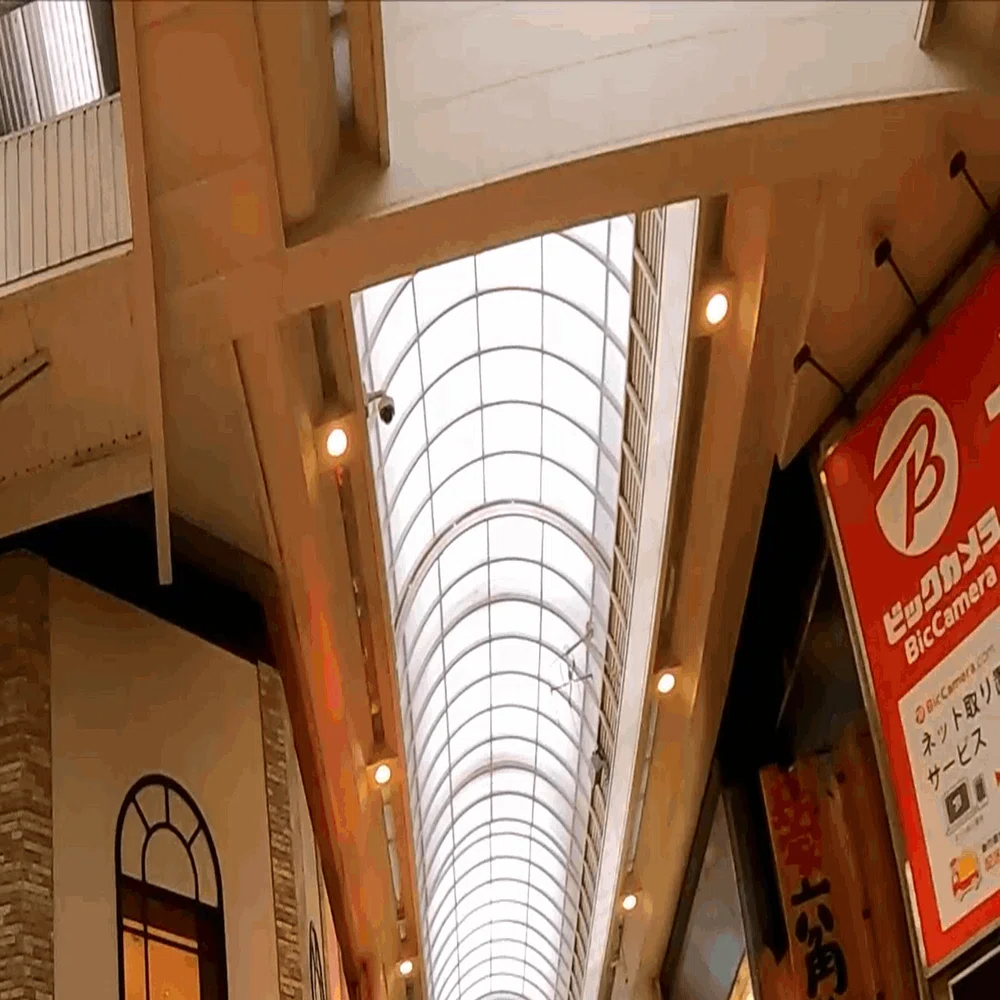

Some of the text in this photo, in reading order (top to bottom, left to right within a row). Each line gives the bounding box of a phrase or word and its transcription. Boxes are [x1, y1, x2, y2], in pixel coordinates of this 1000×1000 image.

[883, 506, 1000, 645] ビックカメラ
[904, 565, 997, 665] BicCamera
[927, 727, 987, 791] サービス
